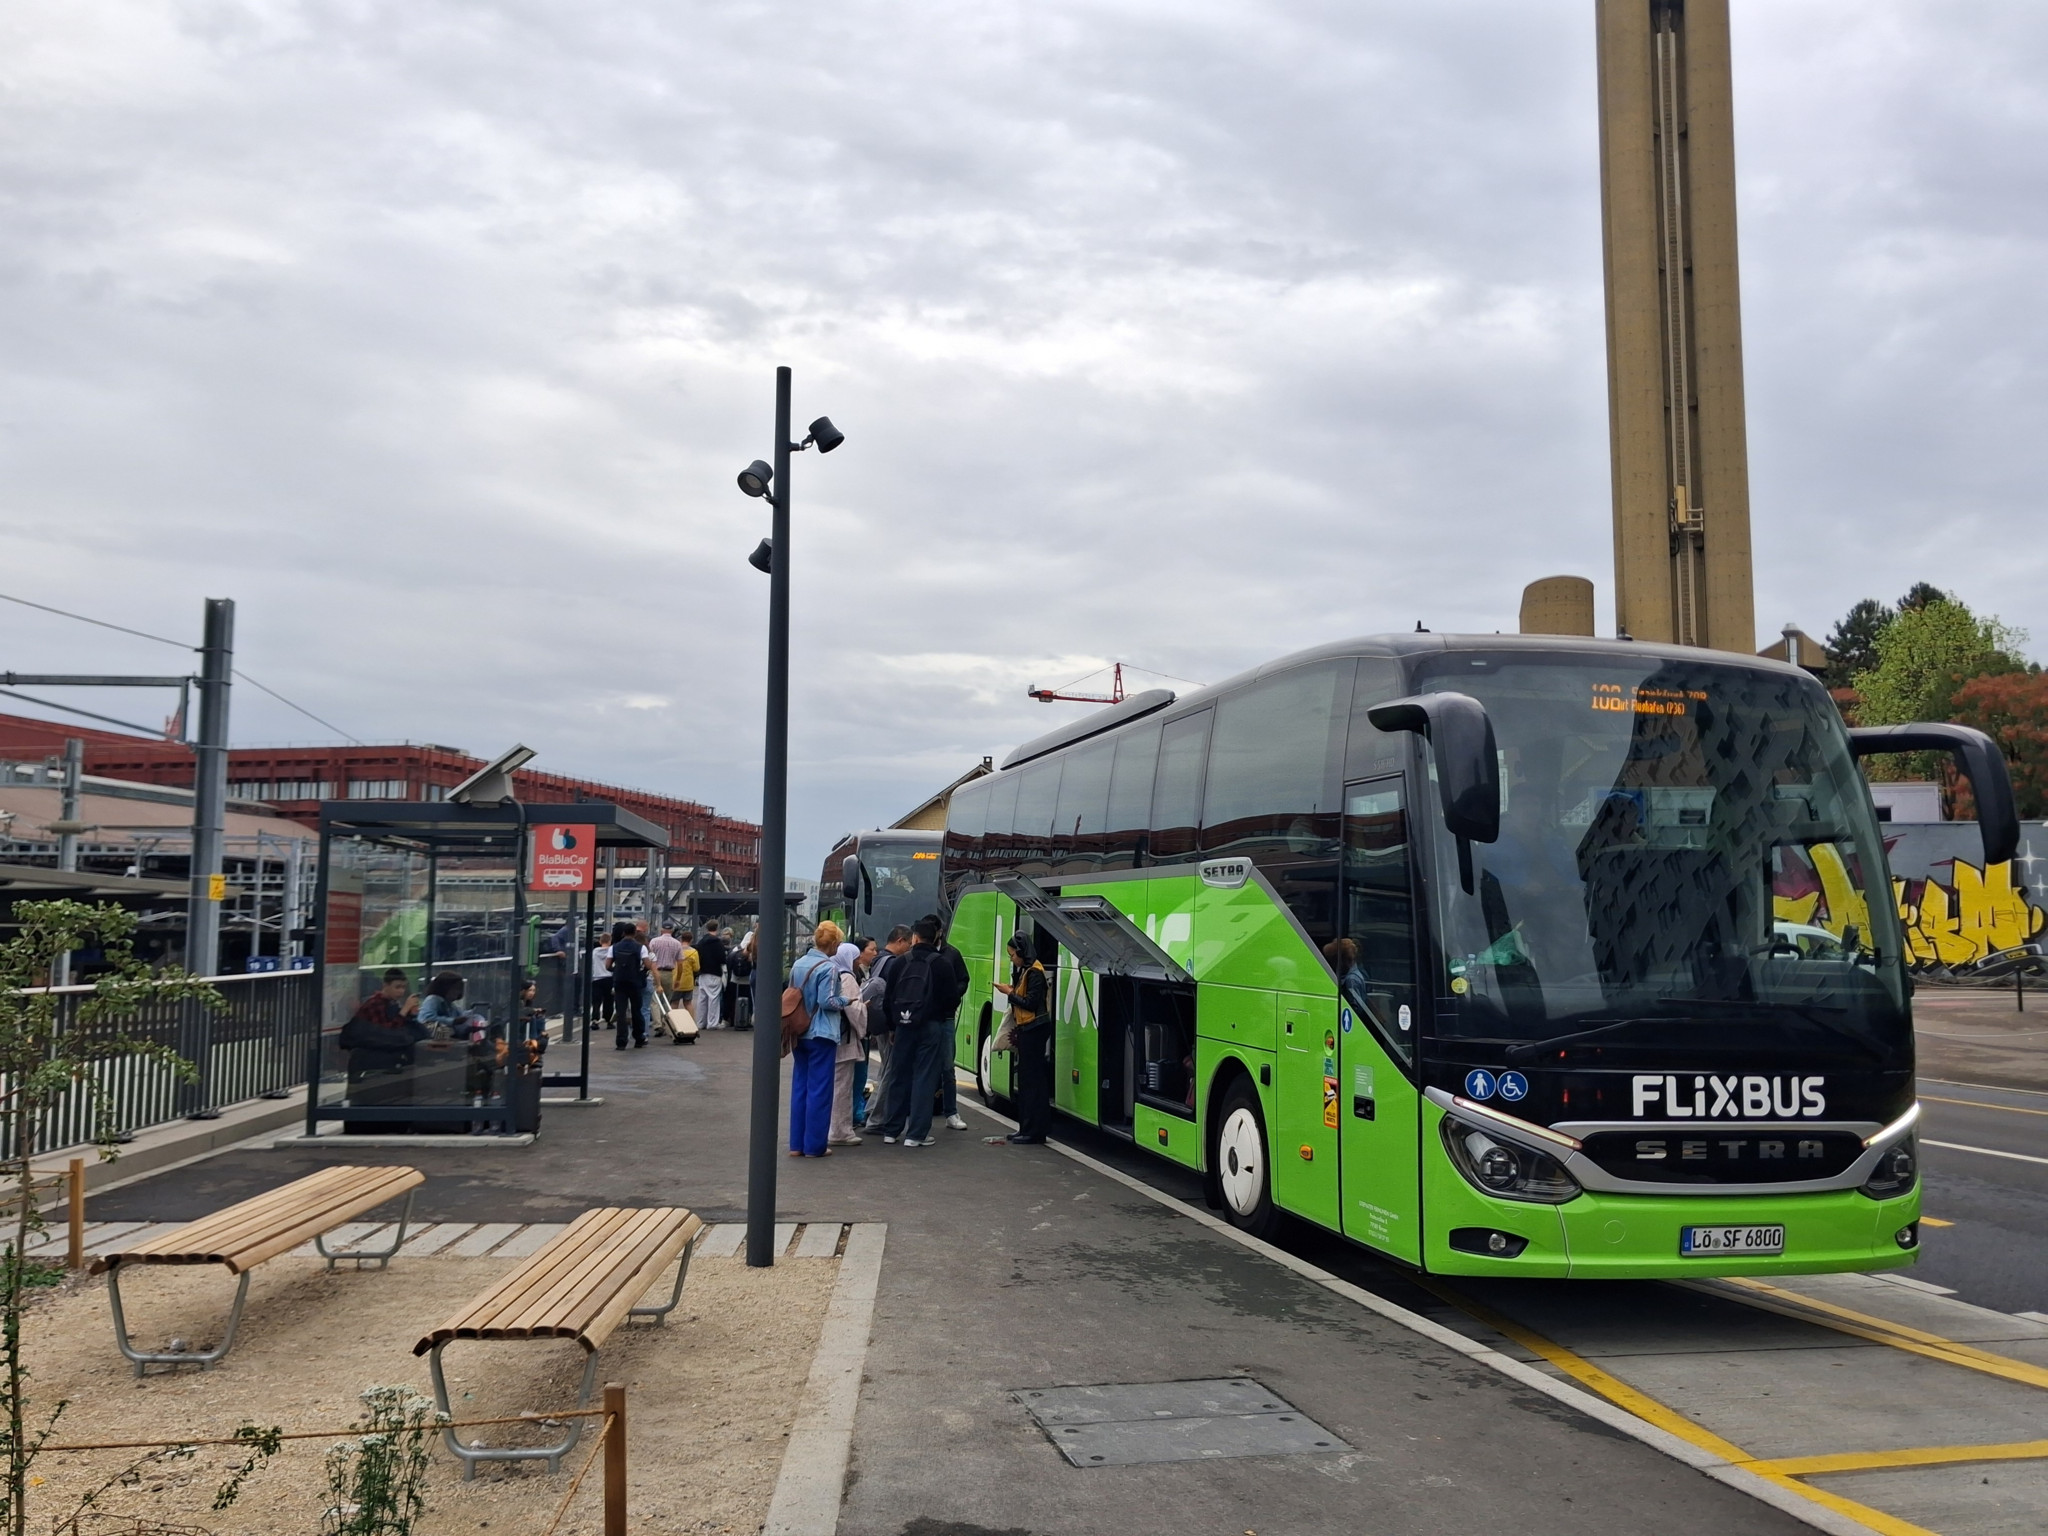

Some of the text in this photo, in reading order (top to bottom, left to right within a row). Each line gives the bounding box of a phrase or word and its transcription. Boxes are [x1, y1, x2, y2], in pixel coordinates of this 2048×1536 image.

[539, 854, 588, 865] BlaBlaCar
[1203, 864, 1244, 878] SETRA
[1635, 1140, 1824, 1160] SETRA
[1692, 1230, 1712, 1249] LÖ
[1723, 1229, 1742, 1248] SF
[1745, 1228, 1782, 1247] 6800
